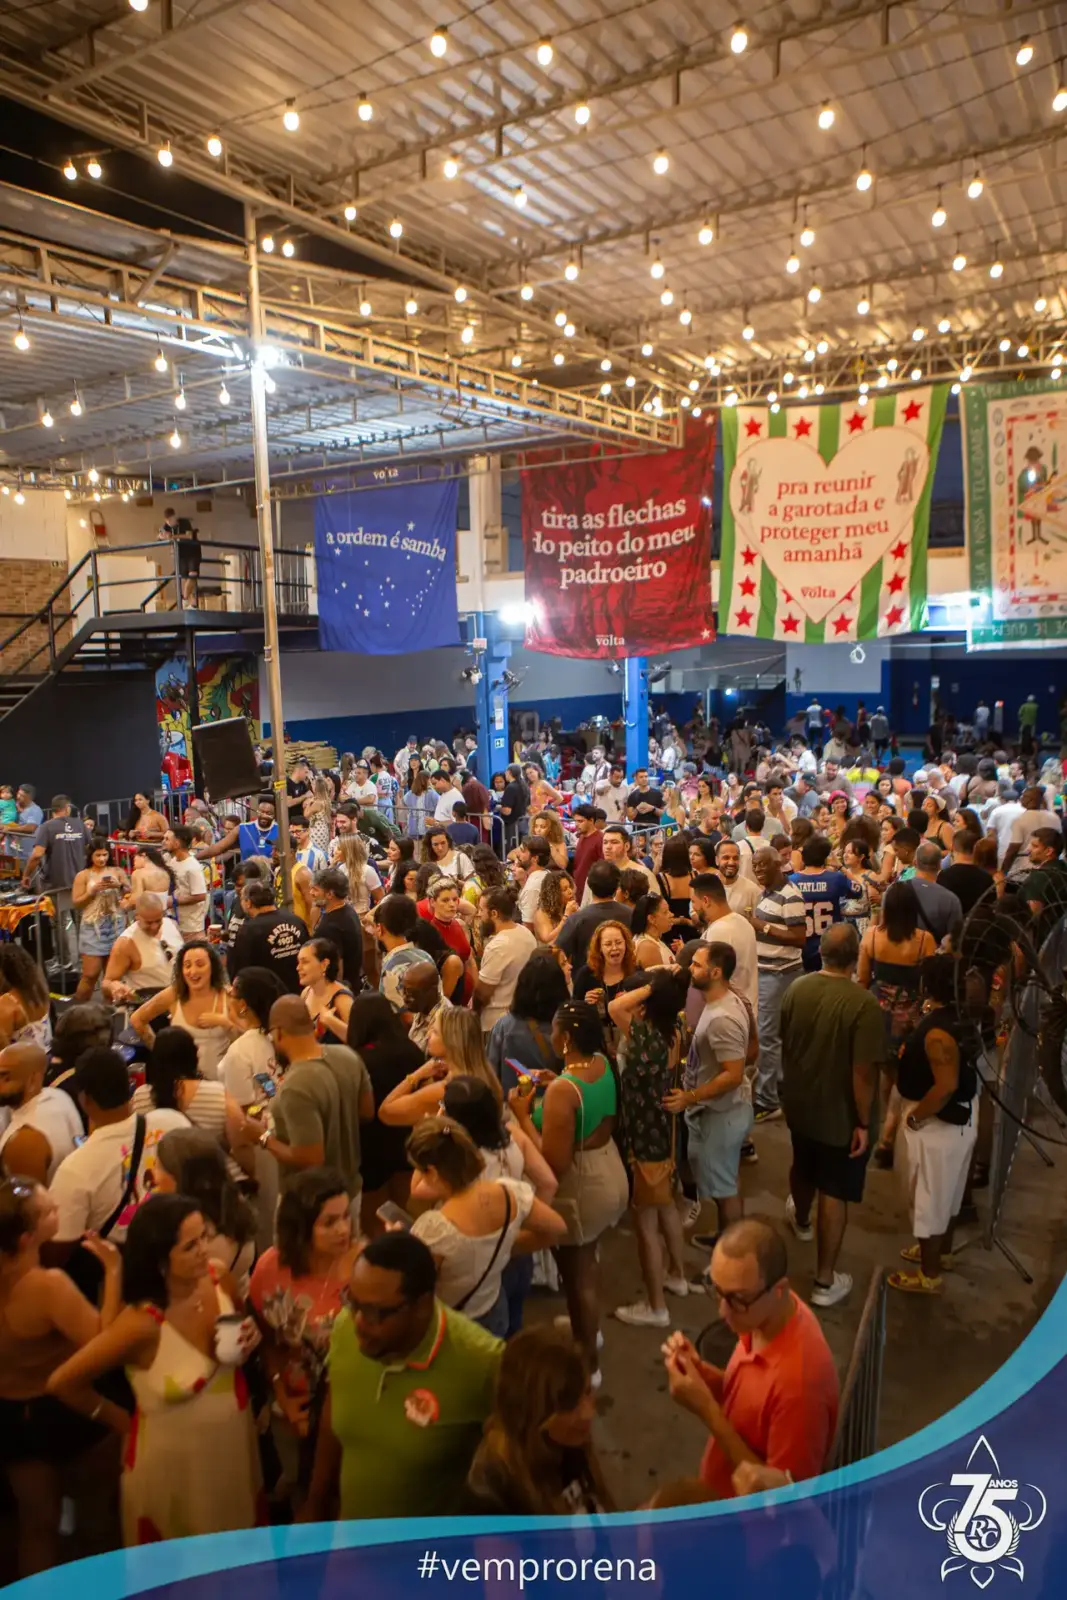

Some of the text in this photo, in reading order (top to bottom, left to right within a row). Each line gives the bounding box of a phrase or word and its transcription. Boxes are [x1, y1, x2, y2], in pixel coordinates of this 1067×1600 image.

[373, 467, 399, 480] vota
[777, 471, 876, 500] pra reunir
[541, 498, 686, 530] tira as flechas
[768, 495, 886, 523] a garotada e
[326, 527, 447, 562] a ordem é samba
[558, 534, 612, 563] peito
[616, 530, 644, 555] do
[647, 524, 696, 552] meu
[760, 520, 889, 545] proteger meu
[783, 541, 863, 562] amanhã
[560, 557, 667, 590] padroeiro
[801, 585, 836, 598] volta
[595, 634, 625, 646] volta
[797, 881, 828, 893] TAYLOR
